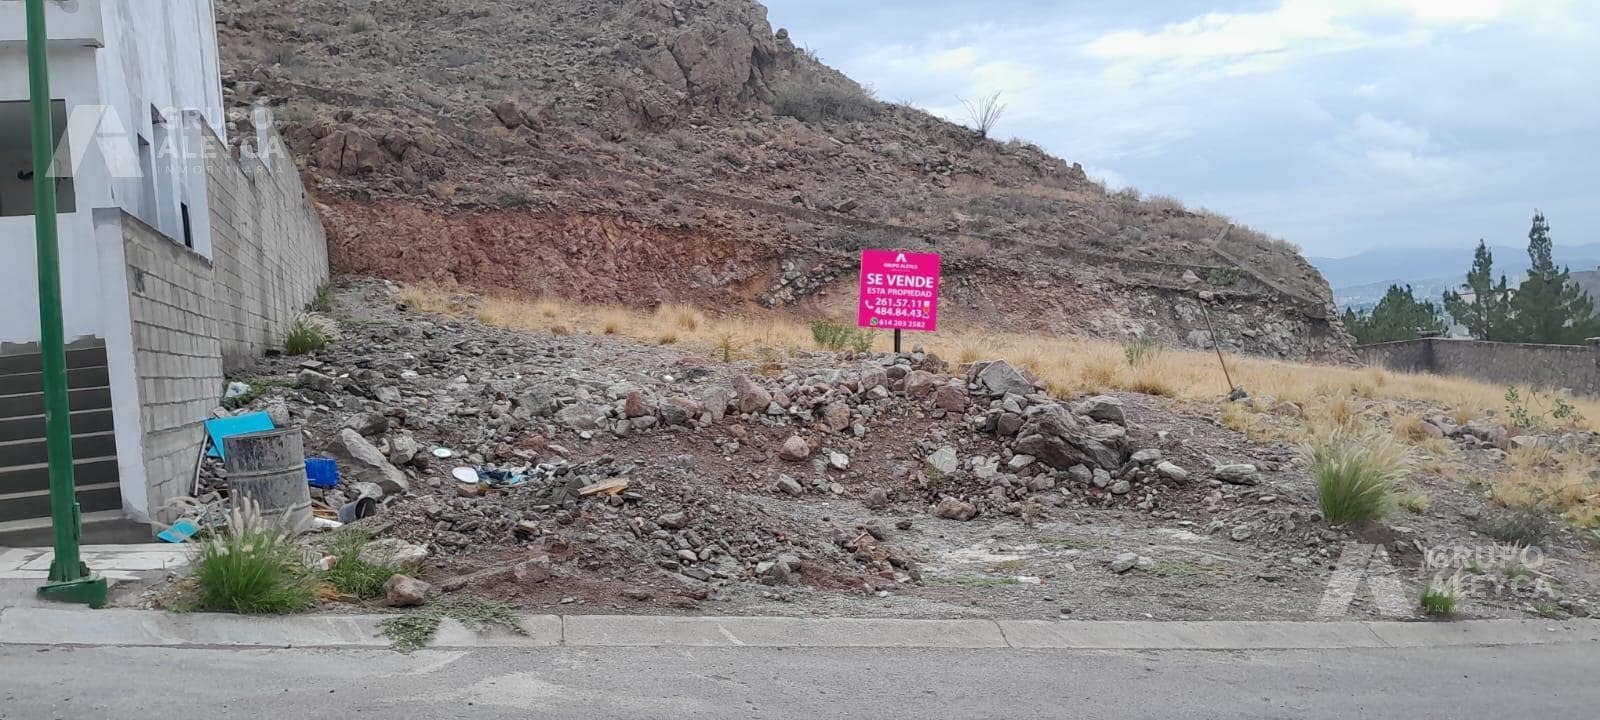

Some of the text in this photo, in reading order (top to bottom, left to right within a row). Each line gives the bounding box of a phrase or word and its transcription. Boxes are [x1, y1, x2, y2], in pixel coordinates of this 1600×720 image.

[867, 273, 934, 288] SE VENDE
[867, 287, 932, 298] ESTA PROPIEDAD
[875, 297, 922, 308] 261.57.11
[875, 307, 922, 318] 484.84.43
